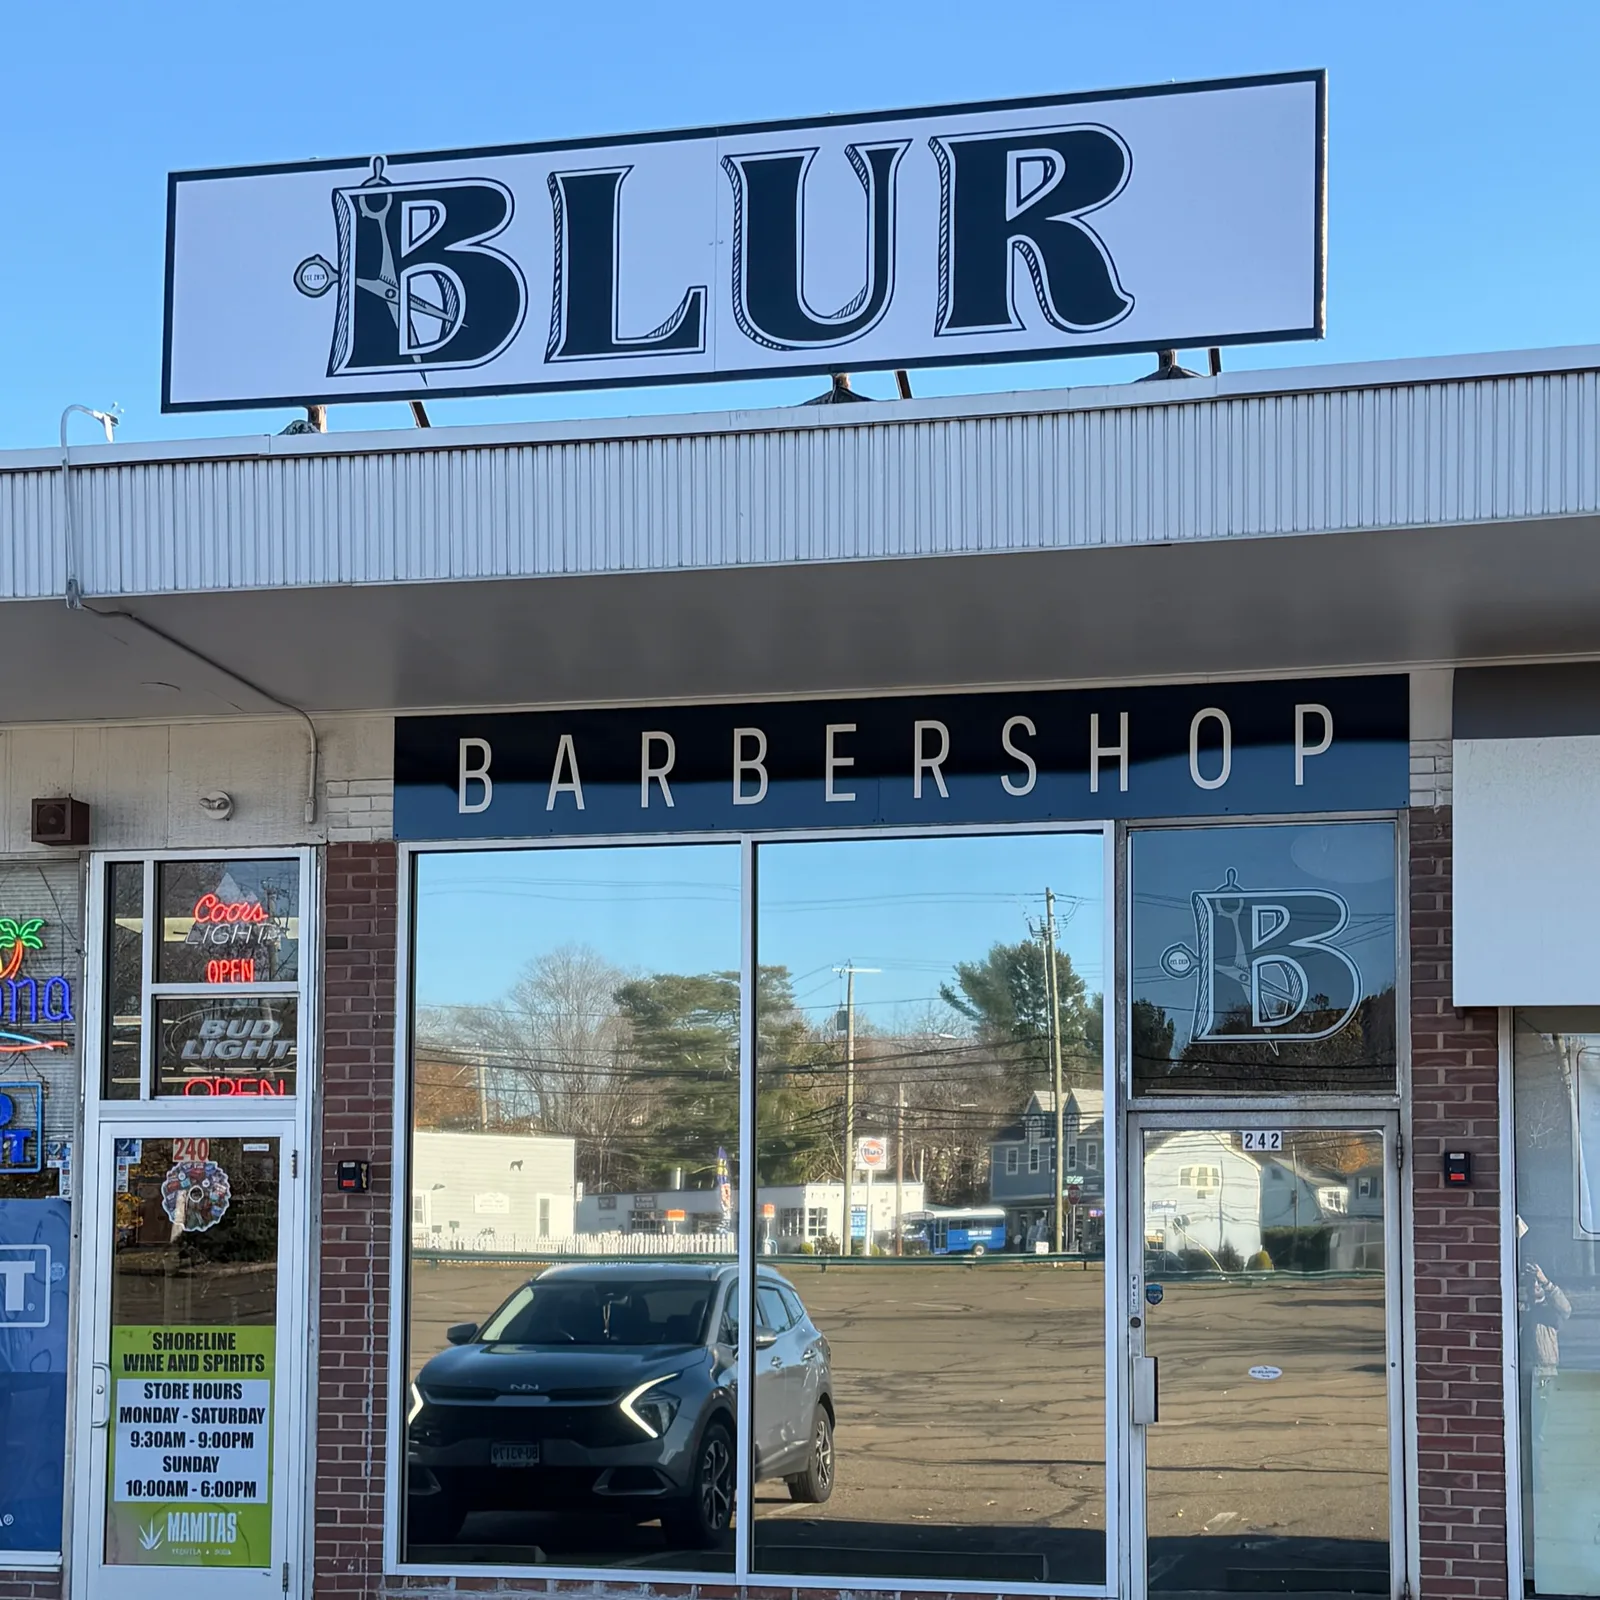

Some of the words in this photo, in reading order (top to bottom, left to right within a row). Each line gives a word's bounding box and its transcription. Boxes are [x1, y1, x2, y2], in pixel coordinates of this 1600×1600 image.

[326, 122, 1136, 377] BLUR
[457, 703, 1335, 815] BARBERSHOP
[193, 892, 269, 923] Coors
[185, 923, 279, 945] LIGHT
[206, 958, 254, 984] OPEN
[1190, 888, 1363, 1043] B
[0, 975, 73, 1023] na
[198, 1019, 282, 1039] BUD
[180, 1039, 294, 1060] LIGHT
[183, 1077, 285, 1096] OPEN
[173, 1139, 209, 1161] 240
[1244, 1132, 1280, 1149] 242
[152, 1332, 236, 1351] SHORELINE
[123, 1354, 164, 1372] WINE
[167, 1354, 199, 1372] AND
[203, 1354, 265, 1373] SPIRITS
[143, 1382, 189, 1400] STORE
[192, 1382, 243, 1400] HOURS
[119, 1407, 180, 1424] MONDAY
[191, 1407, 266, 1425] SATURDAY
[130, 1432, 186, 1449] 9:30AM
[198, 1432, 254, 1449] 9:00PM
[162, 1456, 220, 1473] SUNDAY
[125, 1480, 189, 1498] 10:00AM
[200, 1480, 257, 1498] 6:00PM
[167, 1512, 237, 1543] MAMITAS
